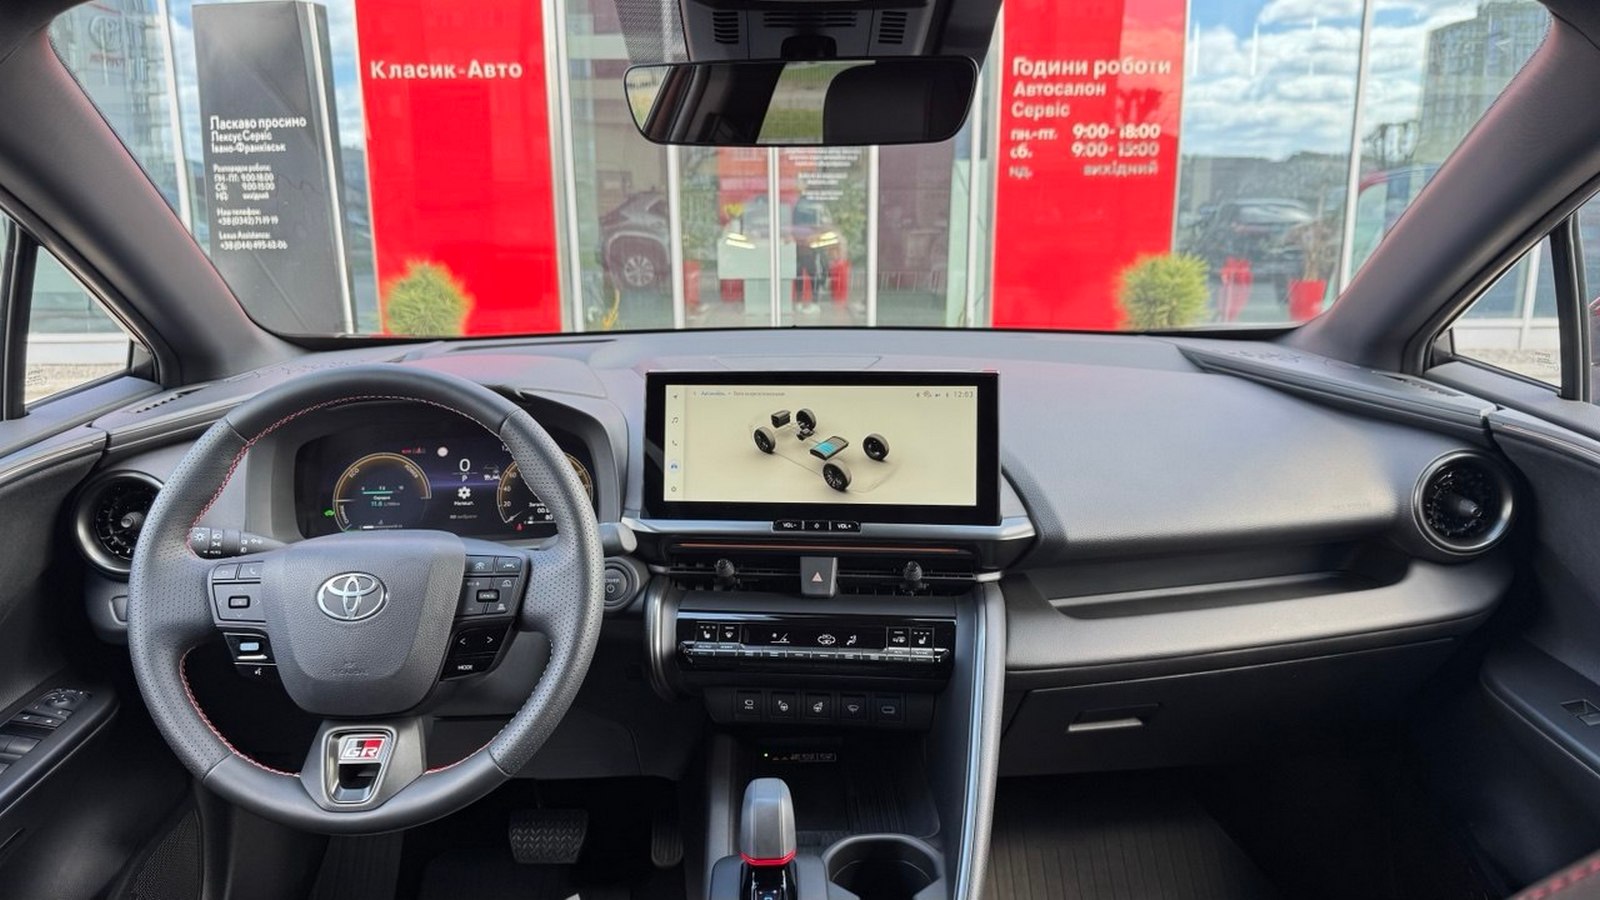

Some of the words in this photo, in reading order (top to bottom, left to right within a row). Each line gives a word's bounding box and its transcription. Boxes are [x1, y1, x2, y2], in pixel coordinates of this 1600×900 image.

[370, 59, 523, 79] Класик-Авто
[1012, 56, 1088, 78] Години
[1093, 56, 1171, 80] роботи
[1013, 81, 1106, 97] Автосалон
[1011, 101, 1070, 121] Сервіс
[258, 116, 307, 131] просимо
[242, 130, 273, 142] Сервіс
[211, 142, 286, 155] Івано-Франківськ
[1009, 143, 1033, 159] сб.
[1083, 162, 1158, 177] вихідний
[459, 458, 471, 472] 0
[461, 474, 468, 482] P
[345, 747, 378, 758] GR
